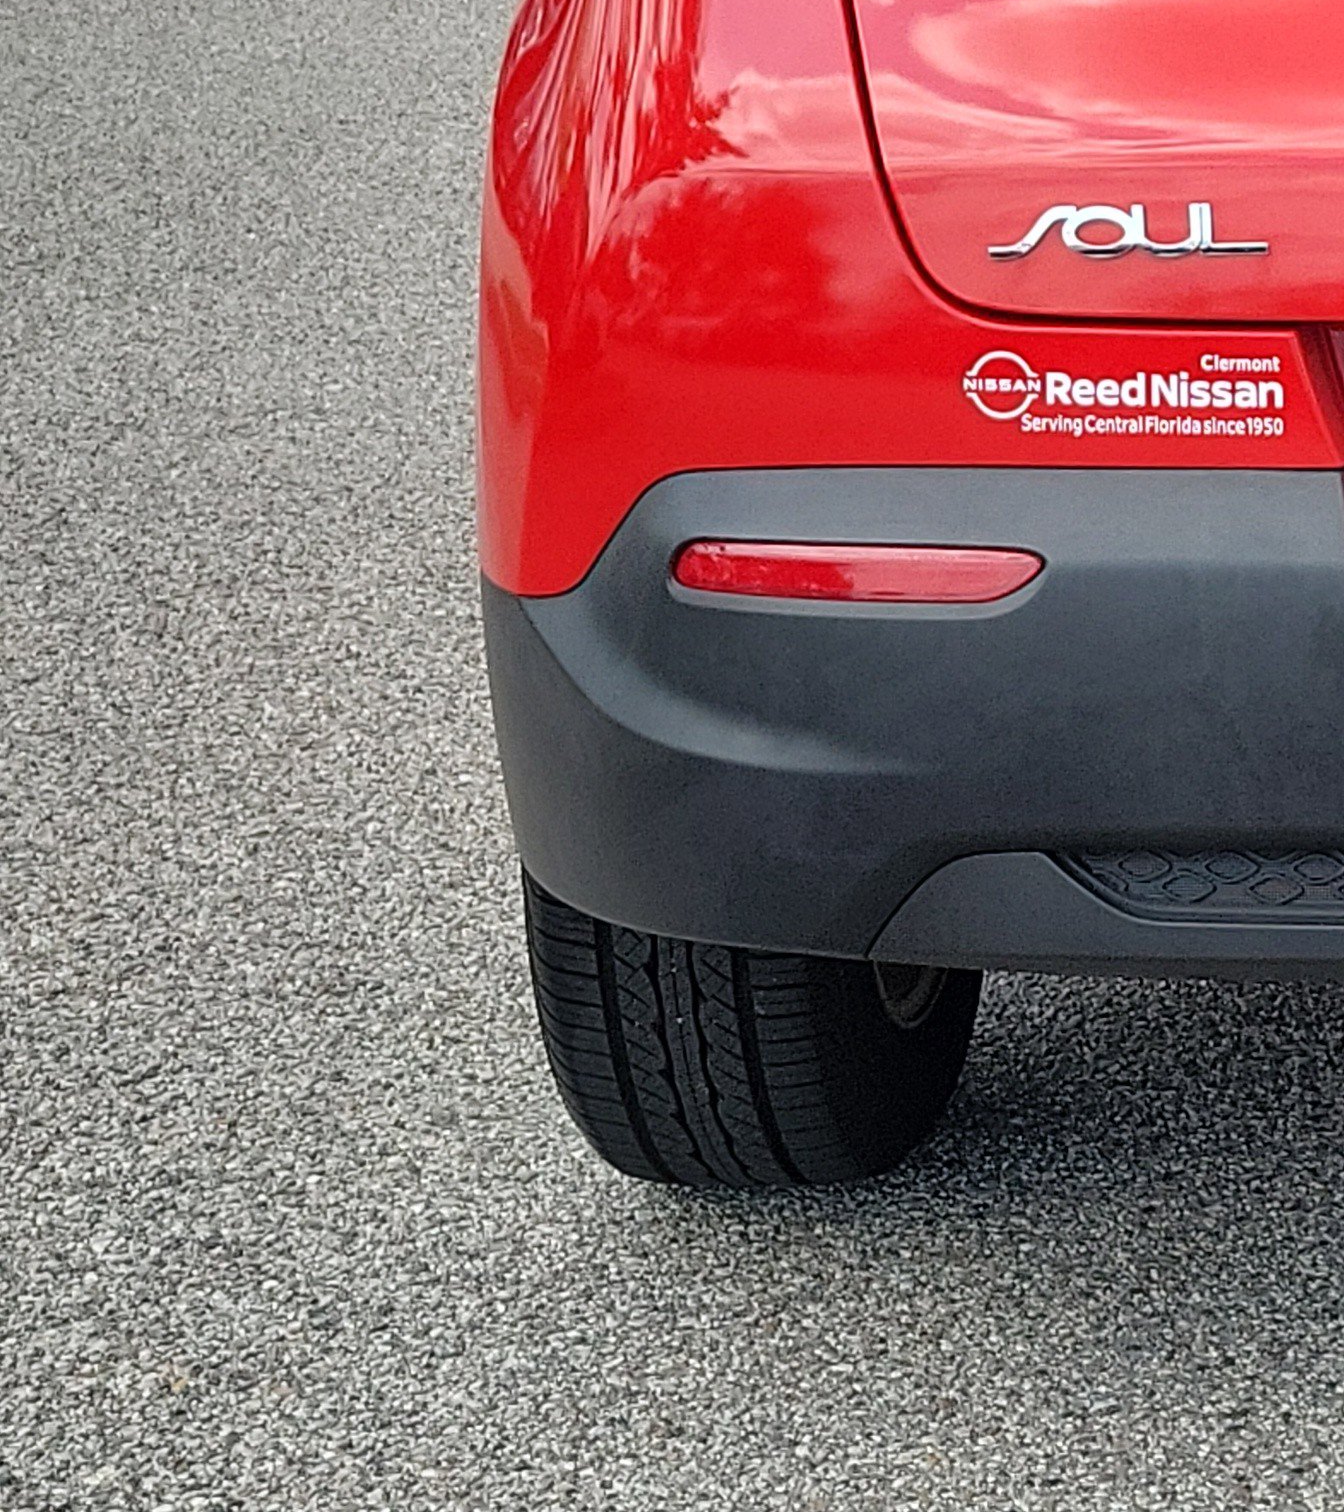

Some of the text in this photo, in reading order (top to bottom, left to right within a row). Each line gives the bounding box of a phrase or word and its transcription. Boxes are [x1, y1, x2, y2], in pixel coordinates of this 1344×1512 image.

[987, 201, 1269, 260] SOUL
[1200, 354, 1280, 373] Clermont
[963, 378, 1041, 392] NISSAN
[1045, 372, 1284, 409] Reed Nissan
[1020, 414, 1083, 437] Serving
[1085, 414, 1143, 434] Central
[1145, 415, 1201, 435] Florida
